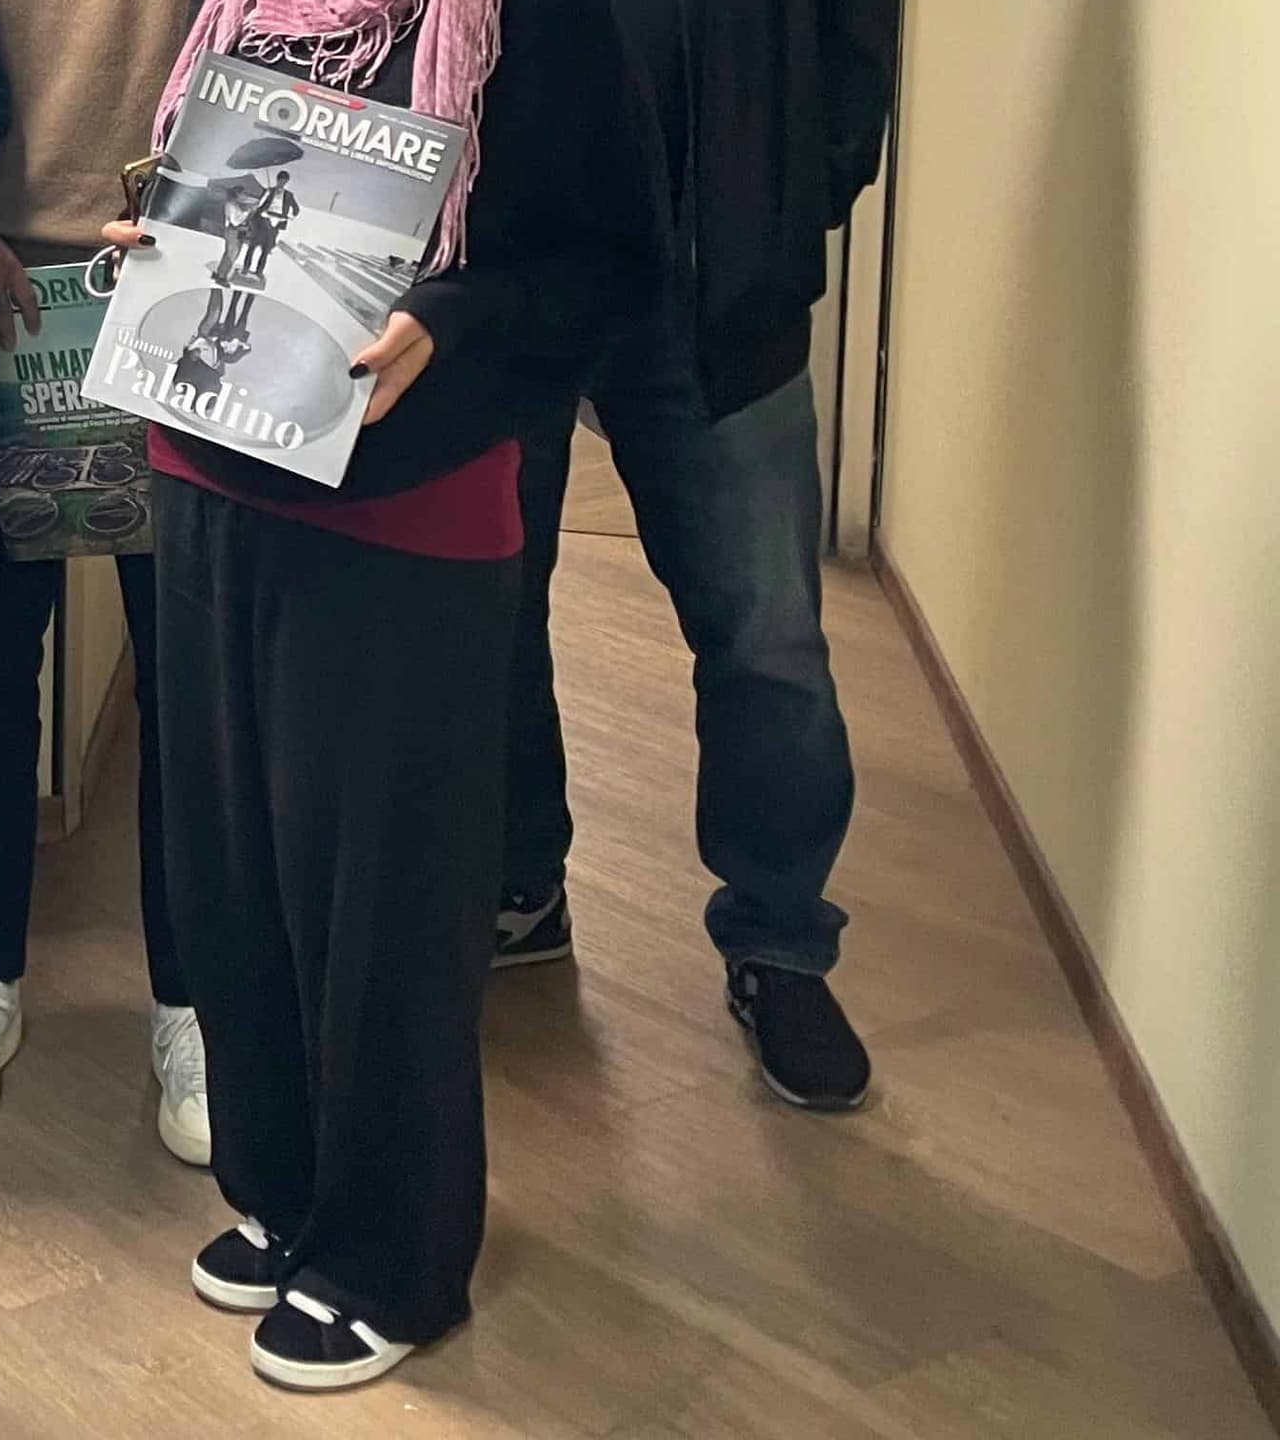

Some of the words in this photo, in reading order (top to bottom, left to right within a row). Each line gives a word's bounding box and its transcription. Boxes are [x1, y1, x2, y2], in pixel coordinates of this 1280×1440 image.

[198, 69, 446, 175] INFORMARE
[14, 351, 46, 381] UN
[103, 344, 305, 451] Paladino
